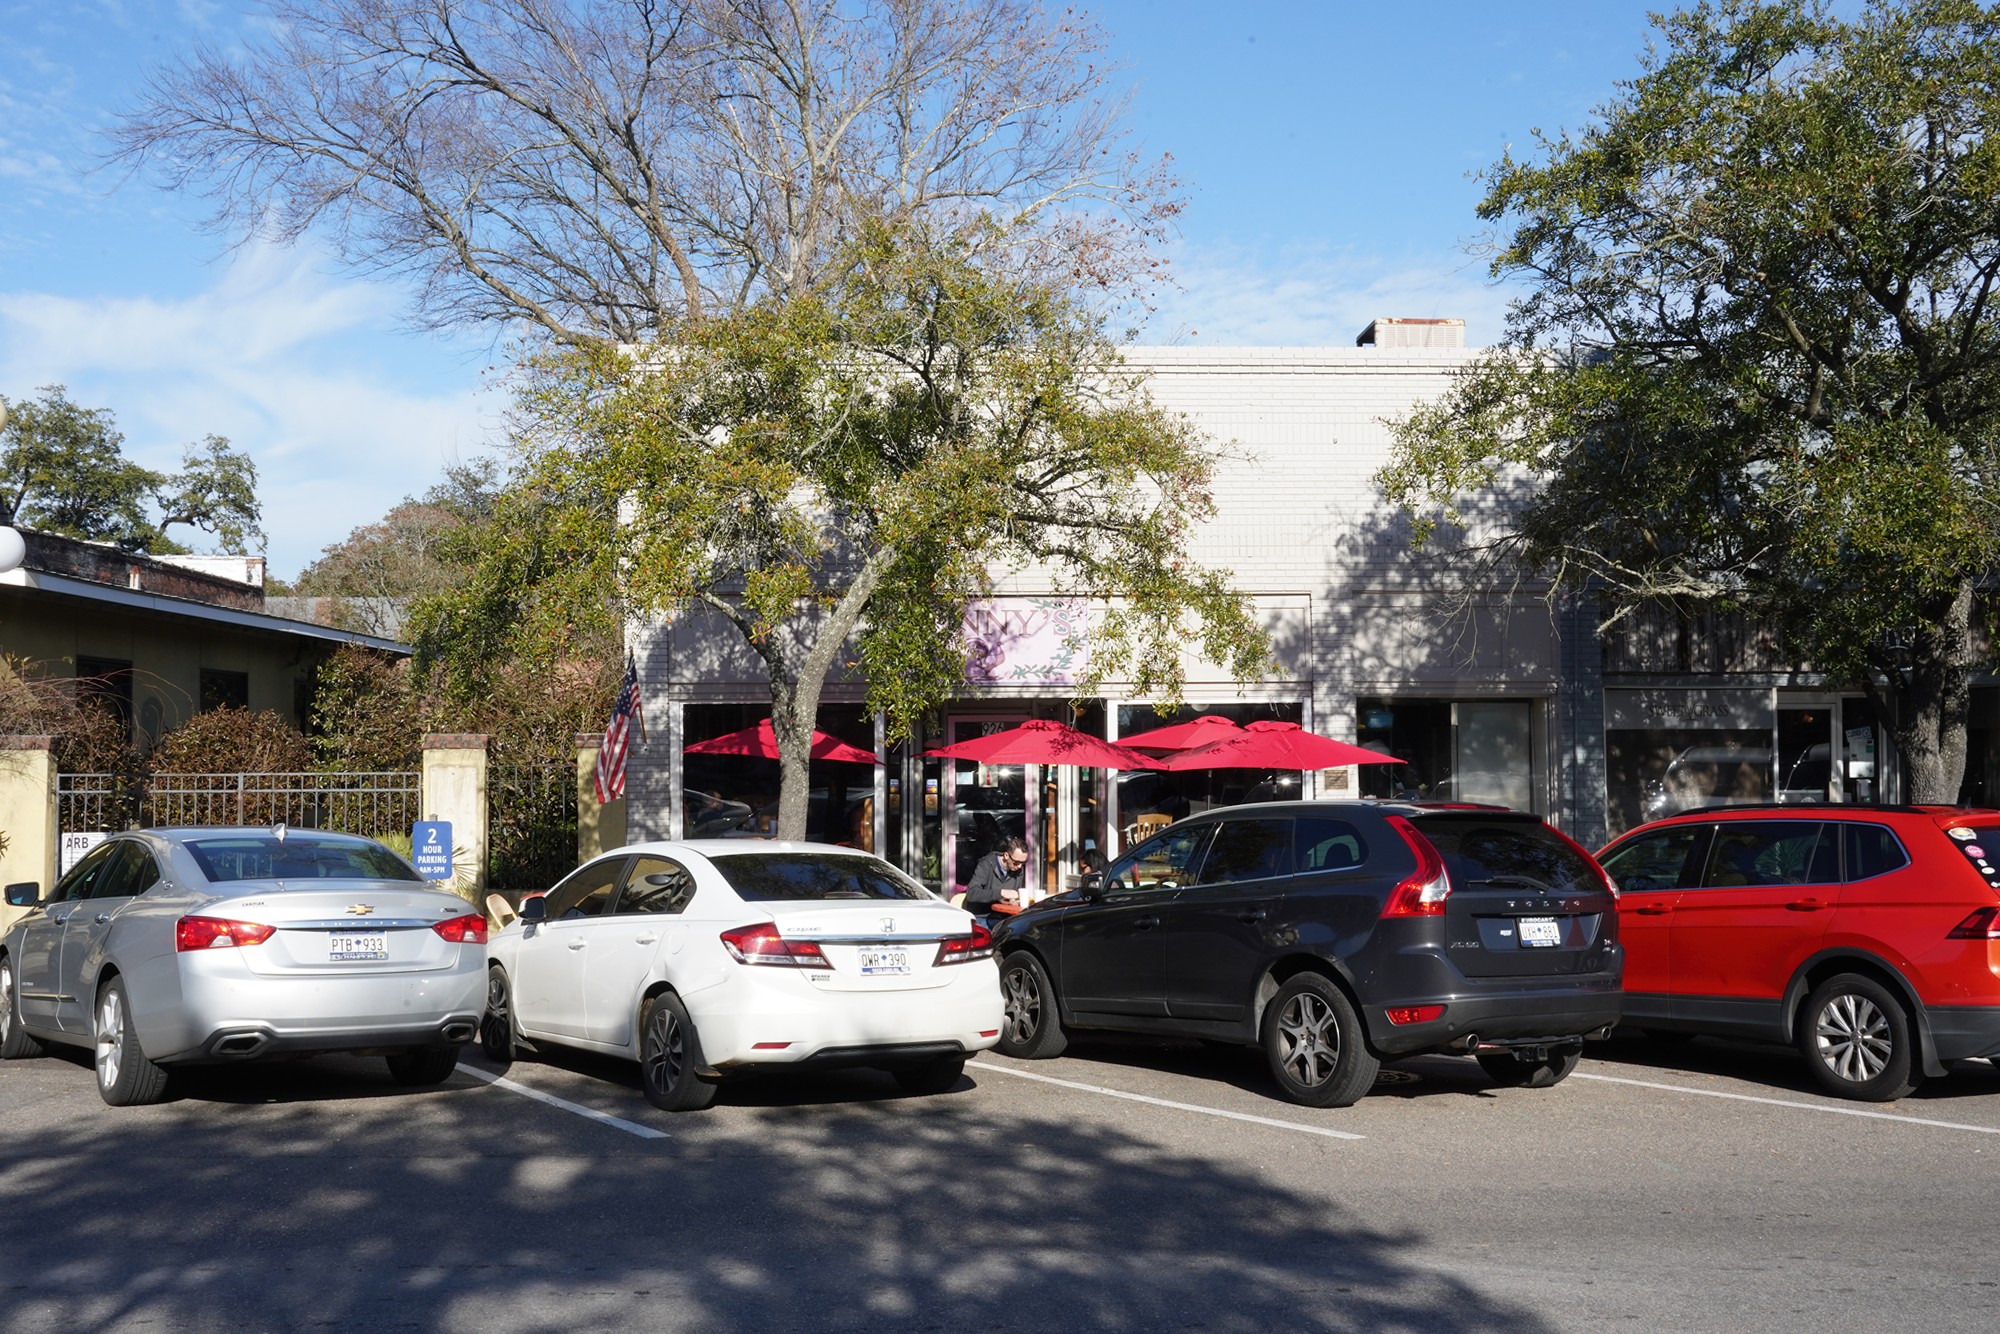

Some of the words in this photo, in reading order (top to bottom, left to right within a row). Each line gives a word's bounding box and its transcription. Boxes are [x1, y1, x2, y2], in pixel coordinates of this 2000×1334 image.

[1693, 700, 1729, 717] GRASS
[982, 721, 1004, 736] 926
[65, 836, 89, 849] ARB
[427, 828, 437, 844] 2
[422, 845, 442, 854] HOUR
[417, 855, 447, 864] PARKING
[1543, 925, 1559, 939] 881
[331, 938, 353, 952] PTB
[362, 938, 383, 951] 933
[861, 953, 880, 967] QWR
[888, 953, 907, 966] 390
